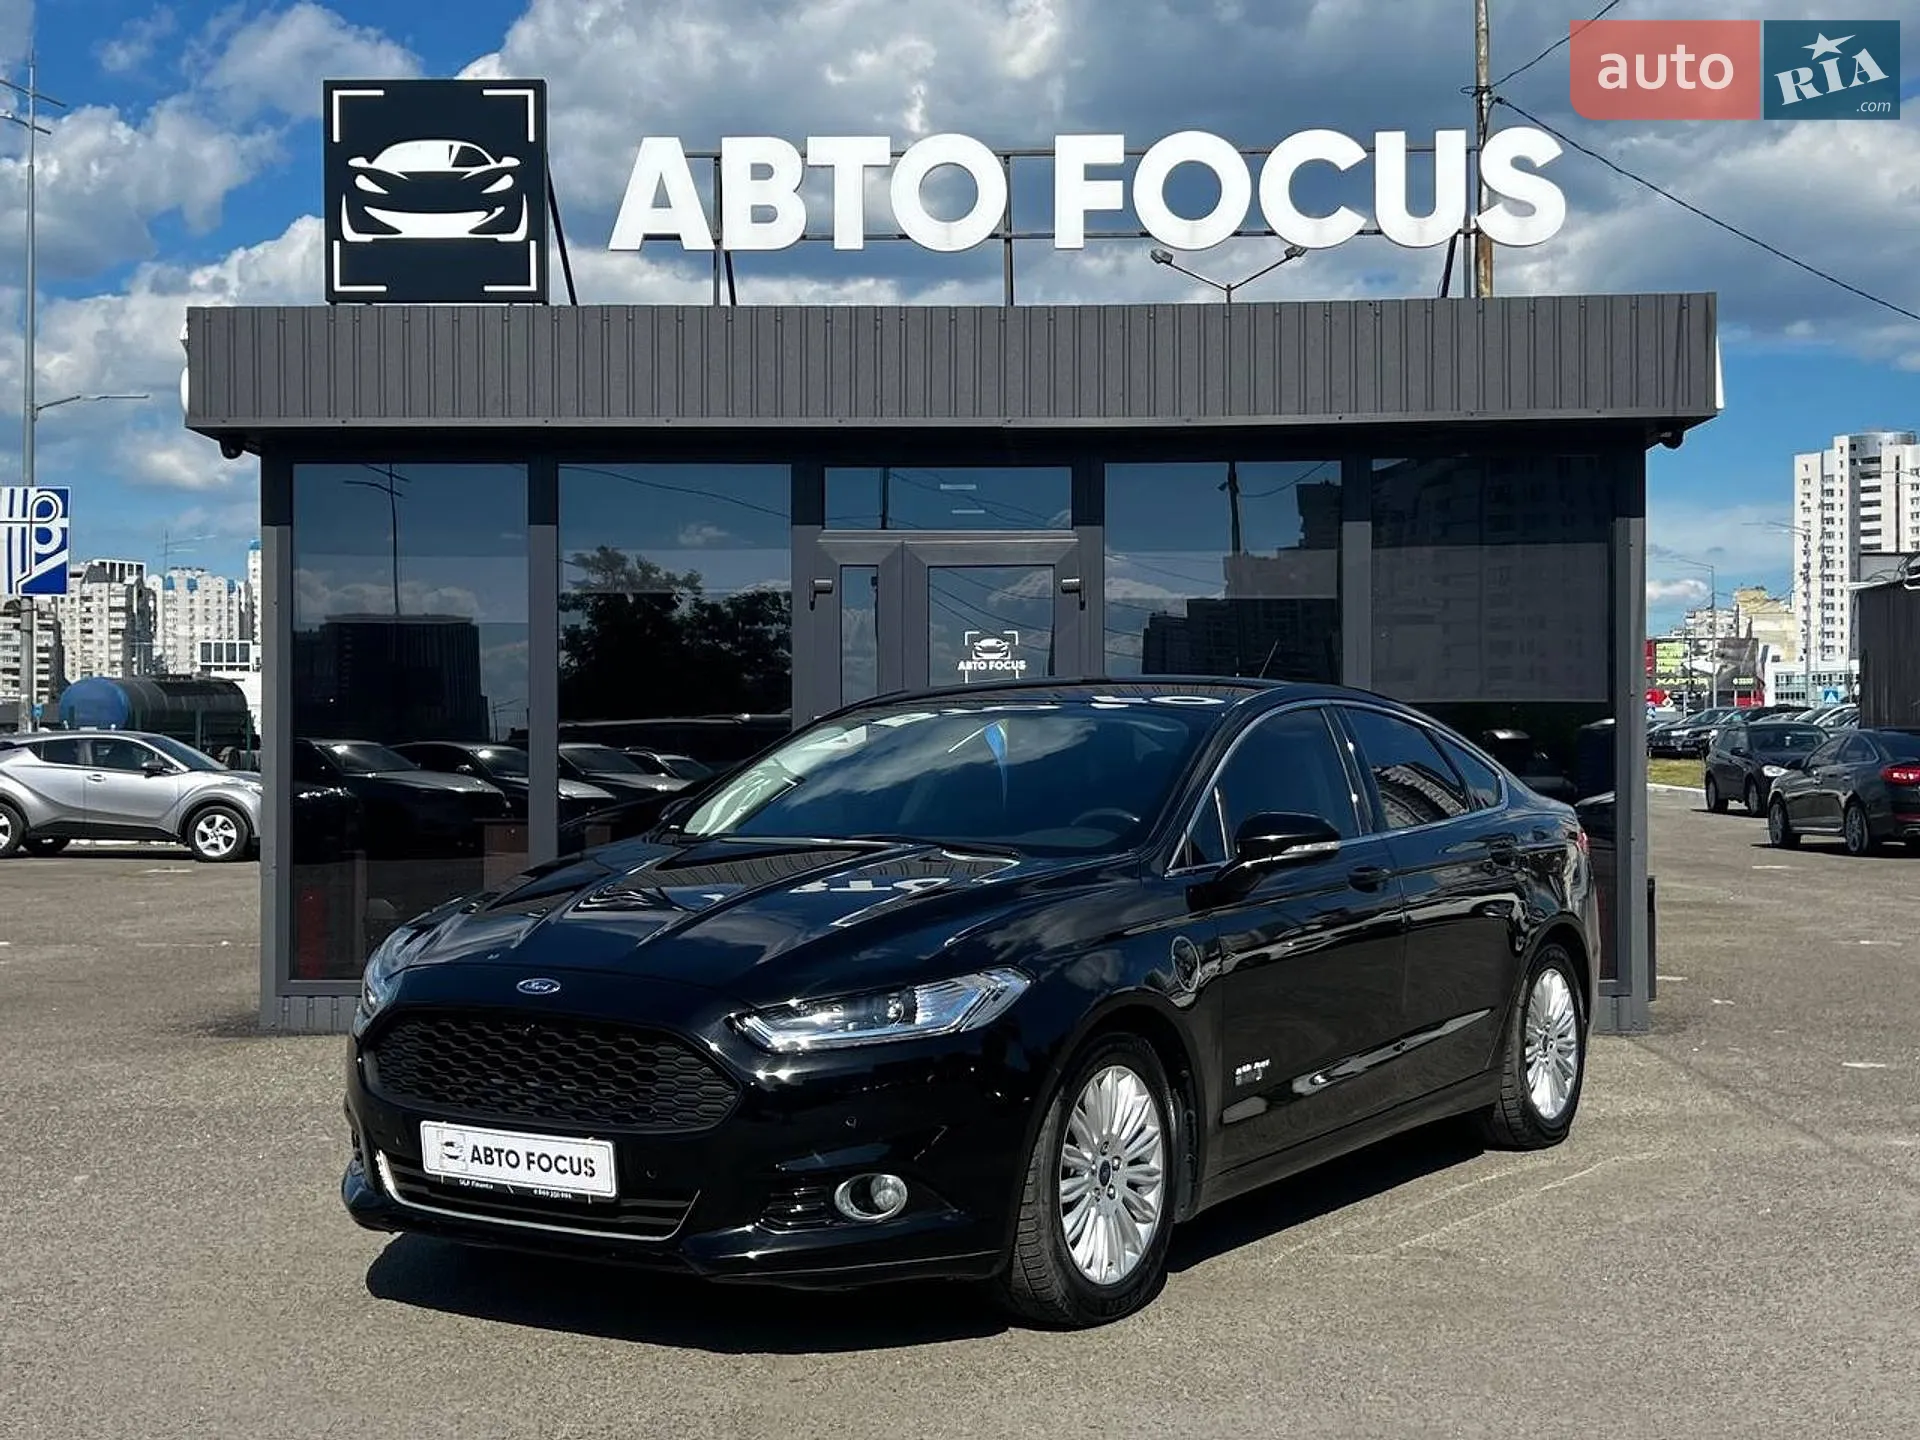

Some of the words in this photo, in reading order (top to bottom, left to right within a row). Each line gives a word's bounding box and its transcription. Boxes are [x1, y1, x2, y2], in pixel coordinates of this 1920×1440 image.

[608, 134, 1008, 251] АВТО
[1054, 127, 1568, 249] FOCUS
[957, 660, 987, 671] АВТО
[989, 660, 1027, 671] FOCUS
[470, 1145, 520, 1169] АВТО
[526, 1152, 596, 1178] FOCUS
